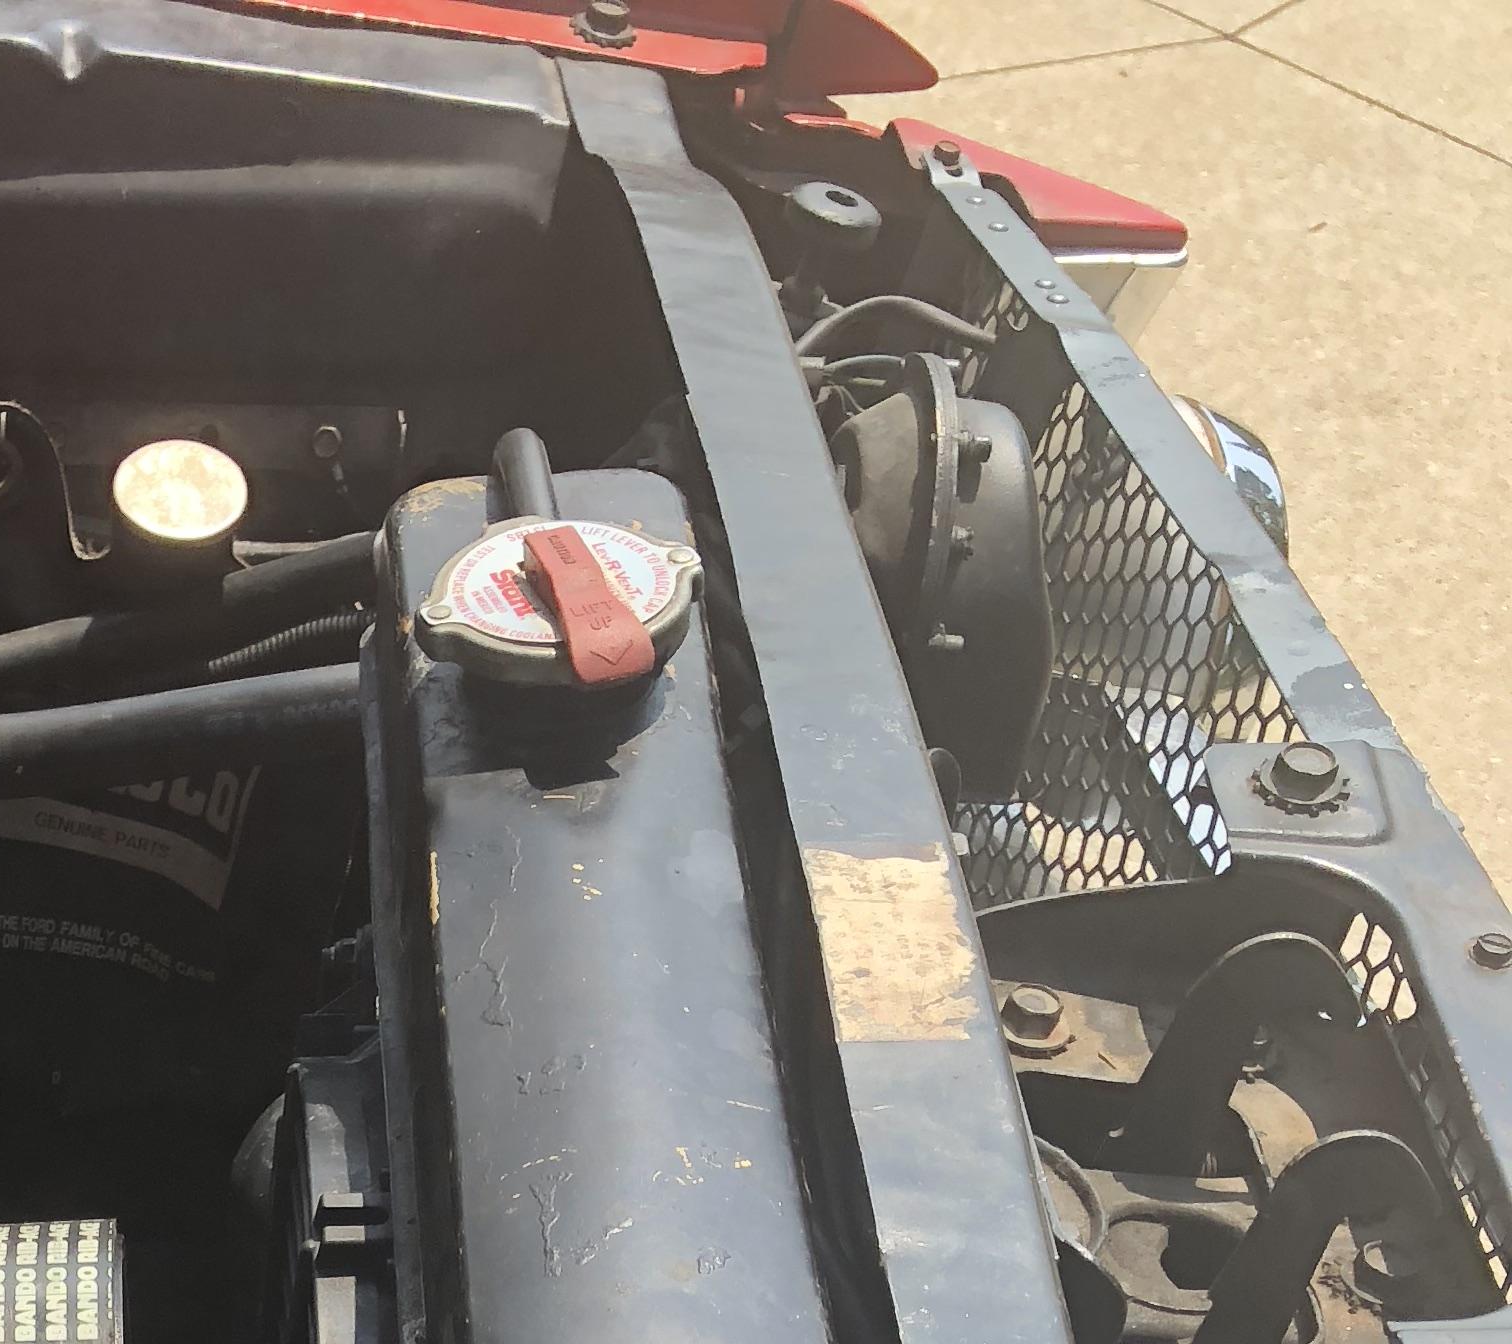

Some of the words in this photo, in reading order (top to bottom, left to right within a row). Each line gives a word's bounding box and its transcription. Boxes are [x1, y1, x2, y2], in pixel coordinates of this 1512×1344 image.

[34, 812, 105, 842] GENUINE
[115, 831, 172, 859] PARTS
[2, 933, 20, 948] ON
[23, 934, 48, 952] THE
[50, 937, 127, 963] AMERICAN
[22, 916, 56, 935] FORD
[60, 921, 114, 942] FAMILY
[119, 932, 140, 947] OF
[14, 1268, 36, 1342] BANDO
[45, 1267, 68, 1341] BANDO
[76, 1266, 99, 1341] BANDO
